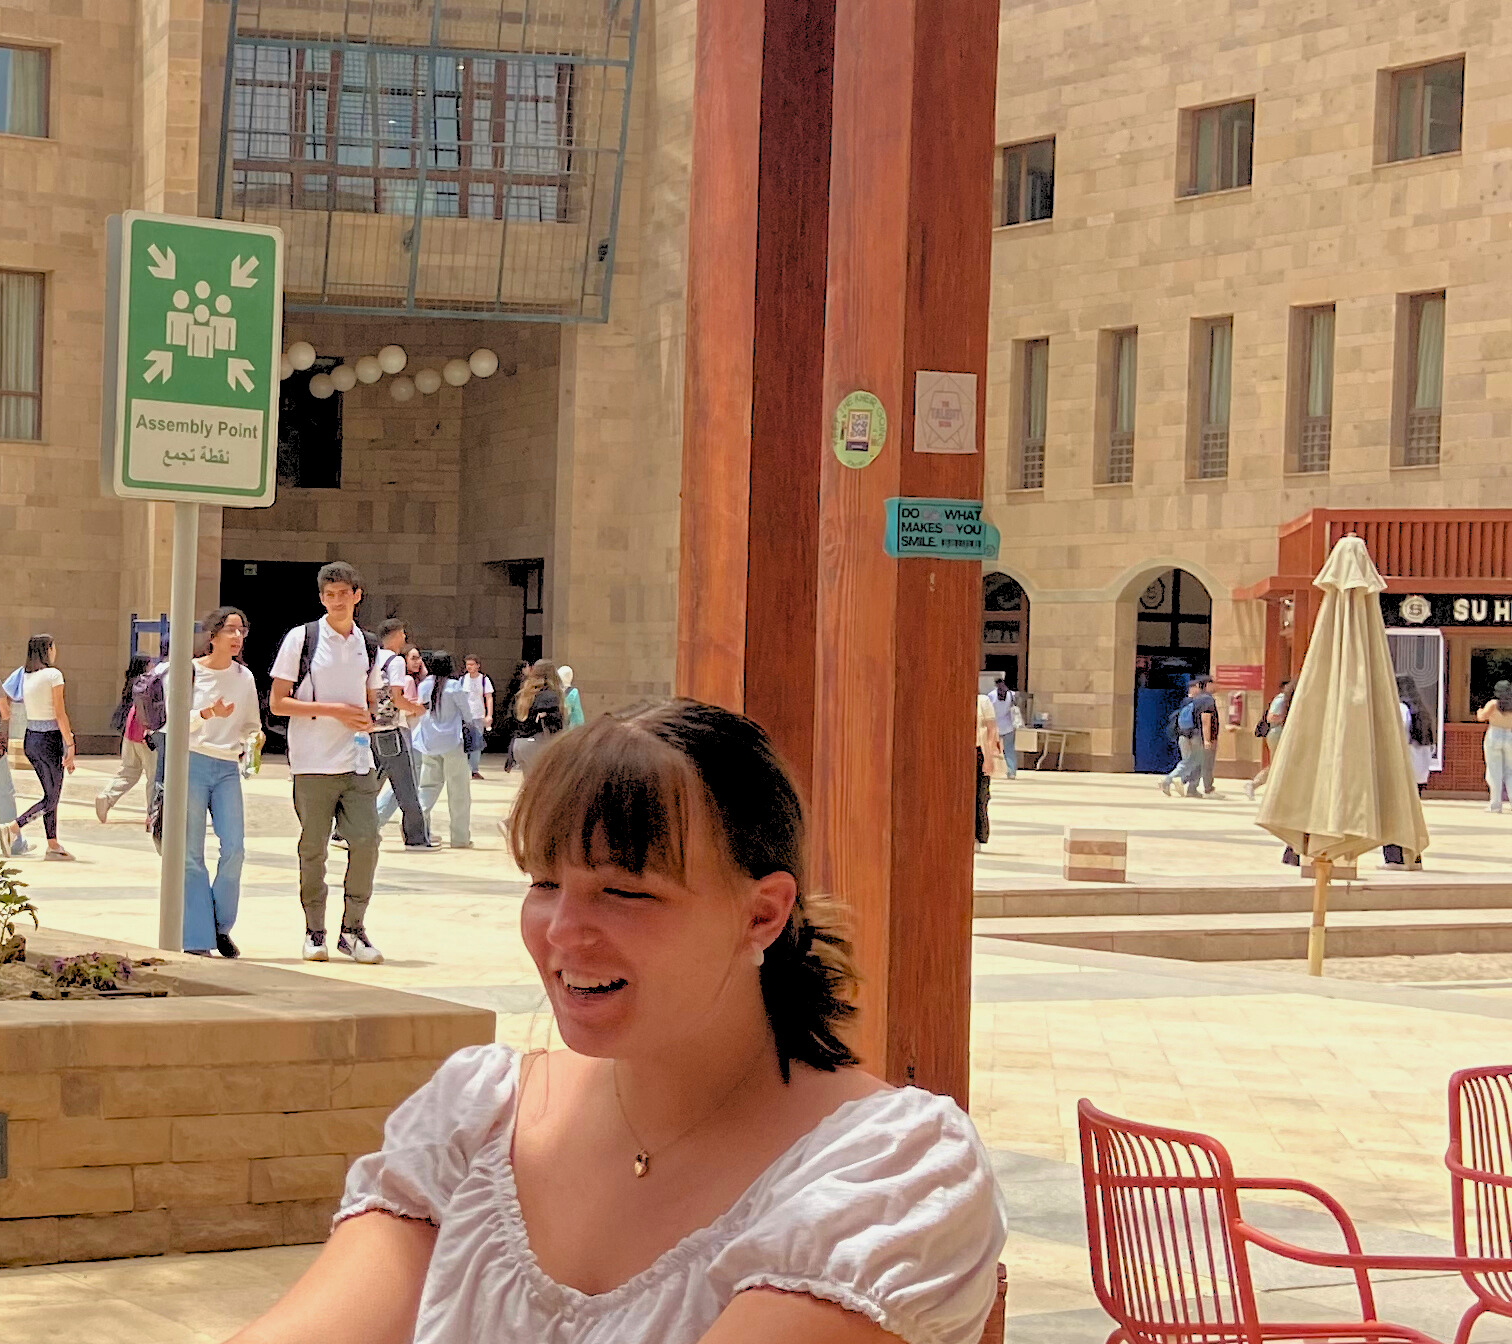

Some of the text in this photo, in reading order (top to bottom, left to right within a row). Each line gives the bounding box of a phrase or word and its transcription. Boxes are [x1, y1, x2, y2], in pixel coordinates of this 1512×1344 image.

[135, 414, 259, 439] Assembly Point
[162, 445, 230, 467] نقطة تجمع
[901, 507, 982, 522] DO WHAT
[901, 522, 982, 535] MAKES YOU
